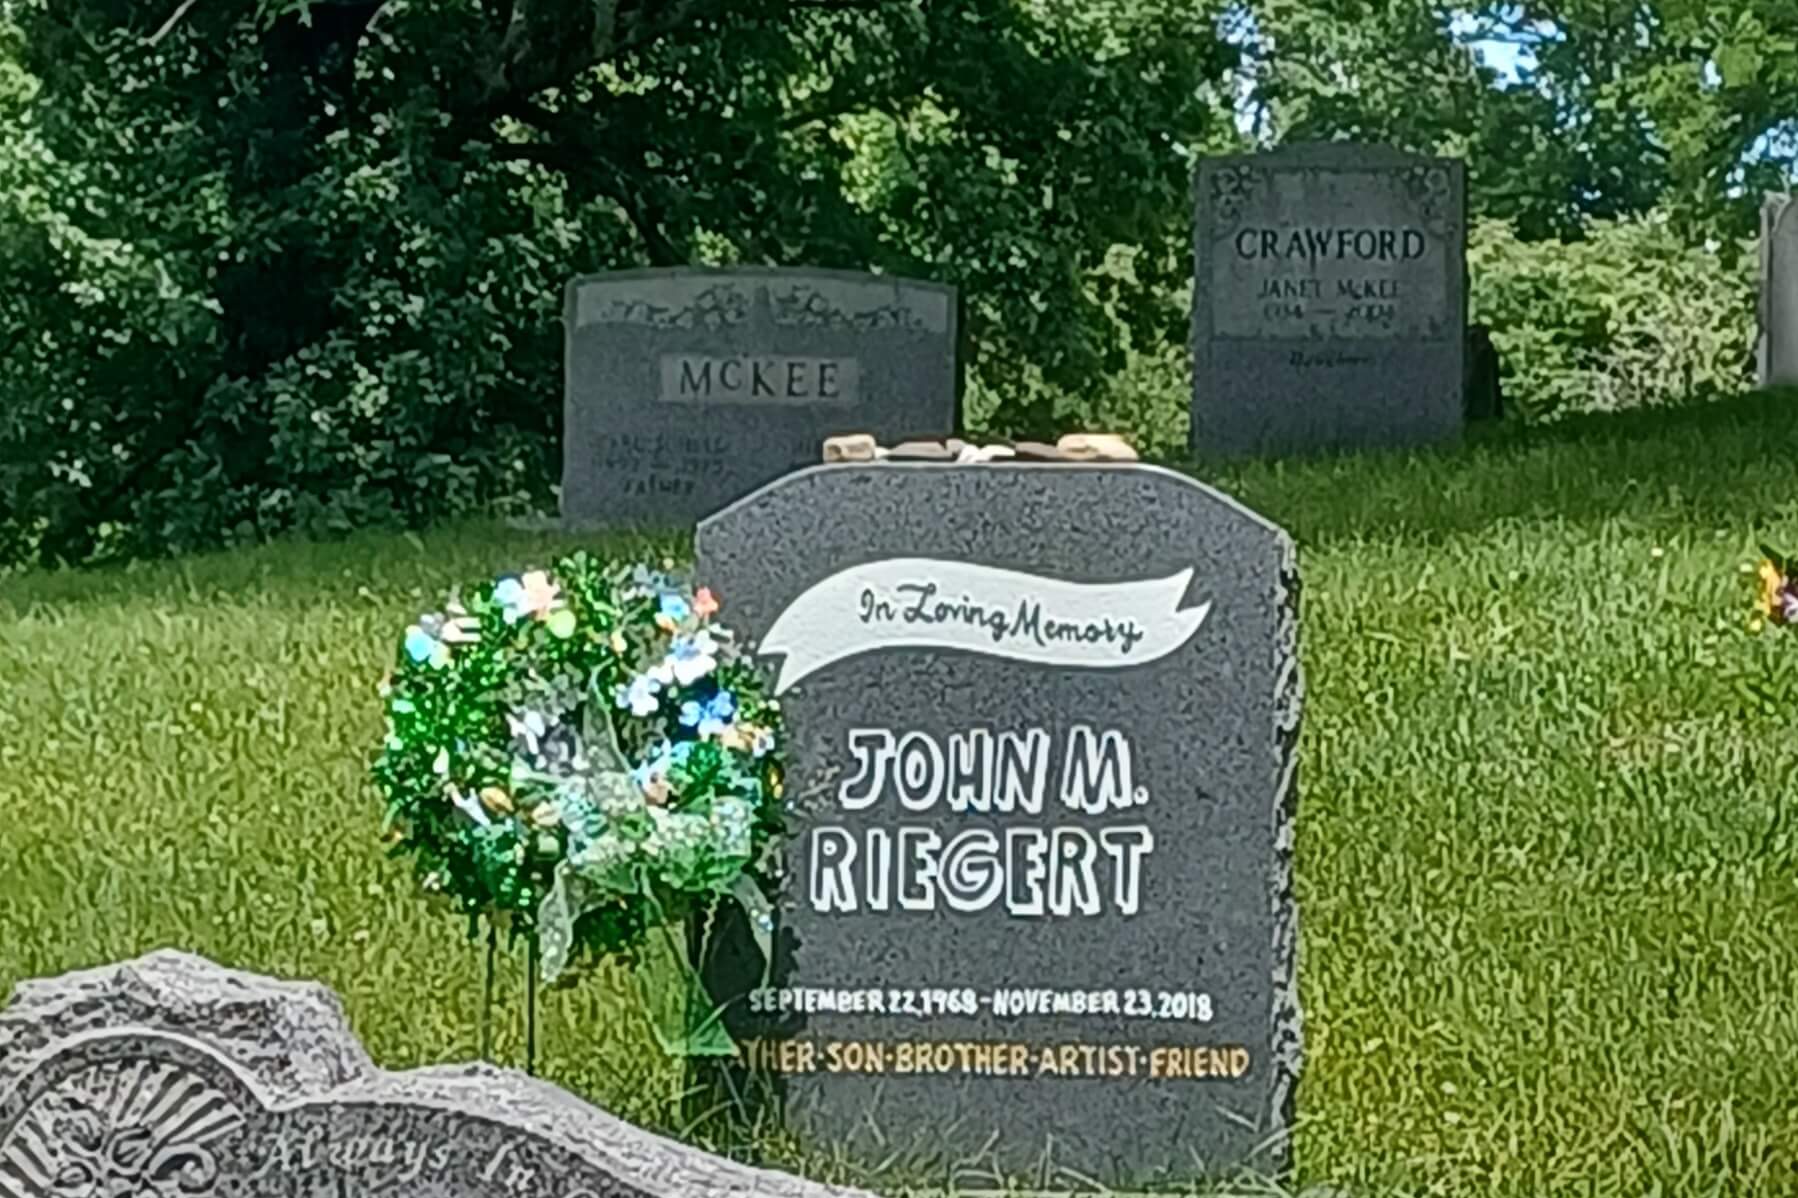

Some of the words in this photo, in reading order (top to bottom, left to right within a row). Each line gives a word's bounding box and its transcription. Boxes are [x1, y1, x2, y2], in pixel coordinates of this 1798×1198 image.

[1235, 227, 1425, 261] CRAWFORD
[859, 588, 895, 623] In
[896, 582, 1008, 642] Loving
[1008, 599, 1143, 653] Memory
[838, 728, 1051, 814] JOHN
[1060, 725, 1150, 815] M.
[810, 825, 1154, 916] RIEGERT
[748, 986, 885, 1014] SEPTEMBER
[249, 1124, 449, 1184] Always
[476, 1135, 536, 1191] In
